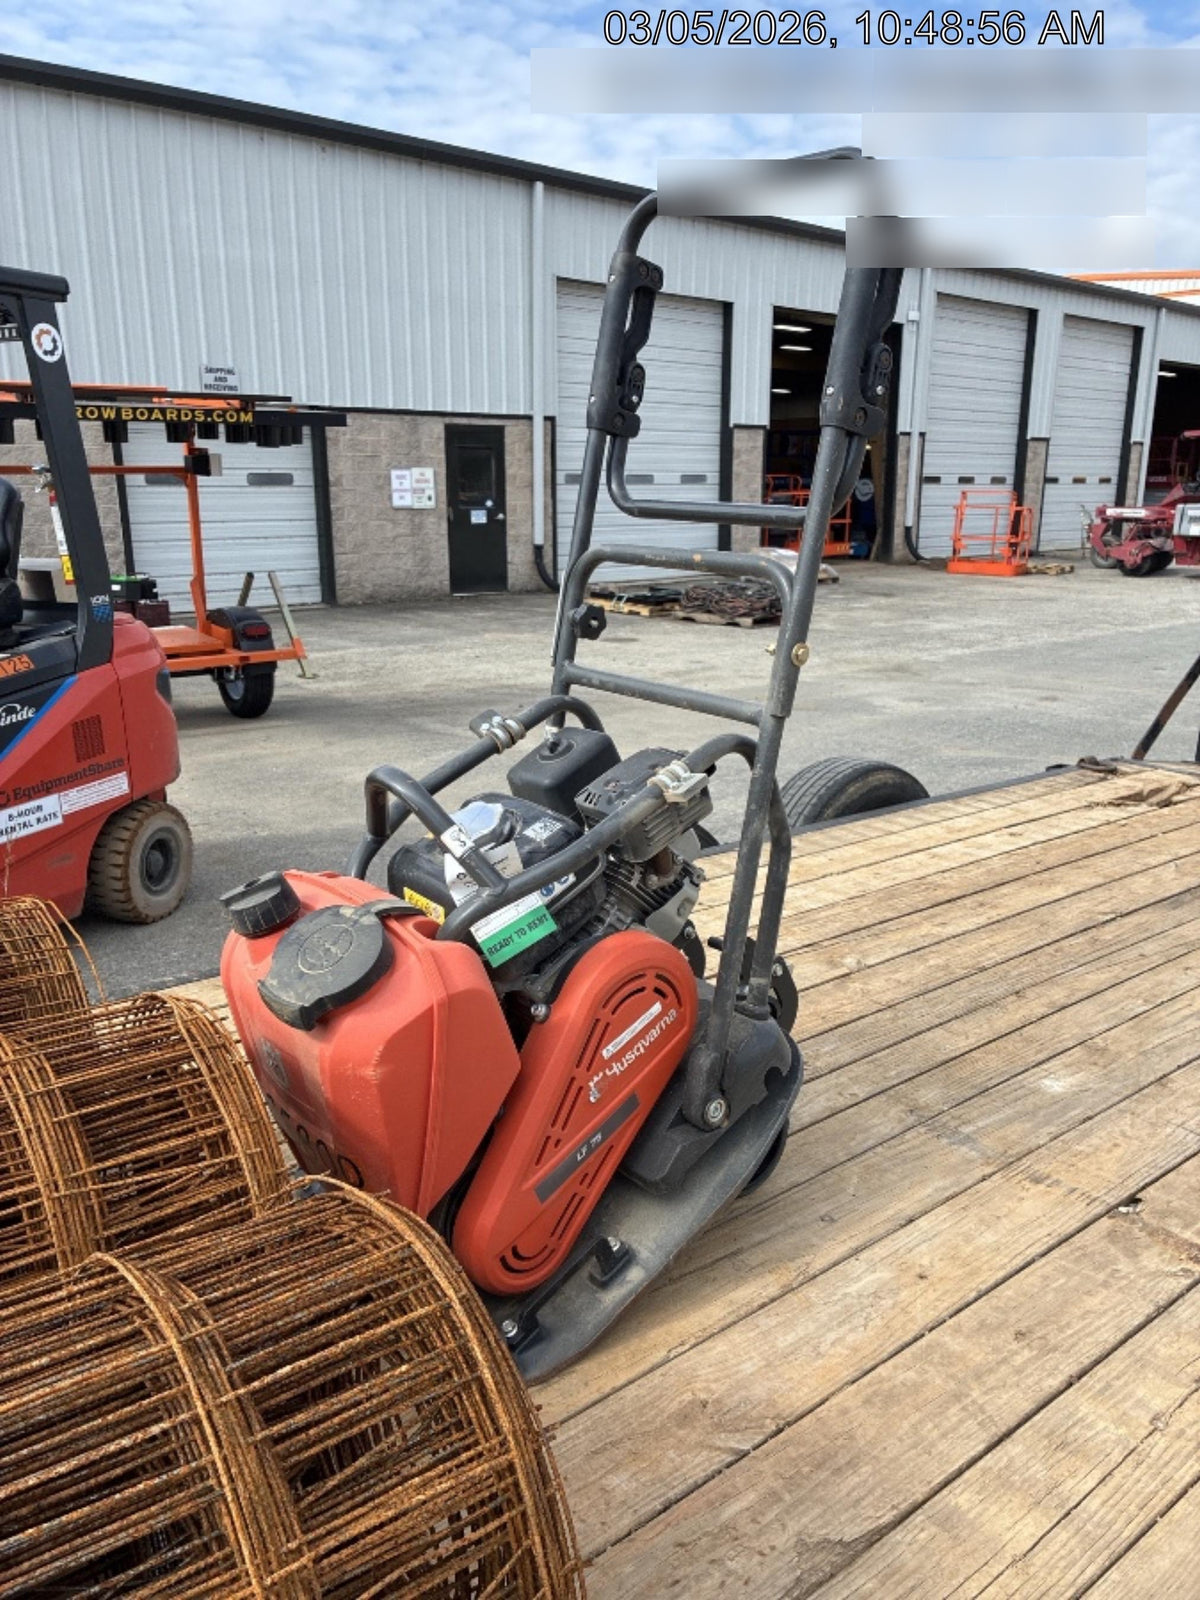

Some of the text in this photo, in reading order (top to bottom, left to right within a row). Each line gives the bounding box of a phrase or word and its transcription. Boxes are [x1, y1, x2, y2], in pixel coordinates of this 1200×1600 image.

[13, 757, 125, 801] EquipmentShare
[36, 811, 59, 825] RATE
[486, 935, 515, 955] READY
[514, 926, 527, 939] TO
[527, 913, 549, 932] RENT
[605, 1009, 677, 1076] Husqvarna
[576, 1143, 588, 1162] LF
